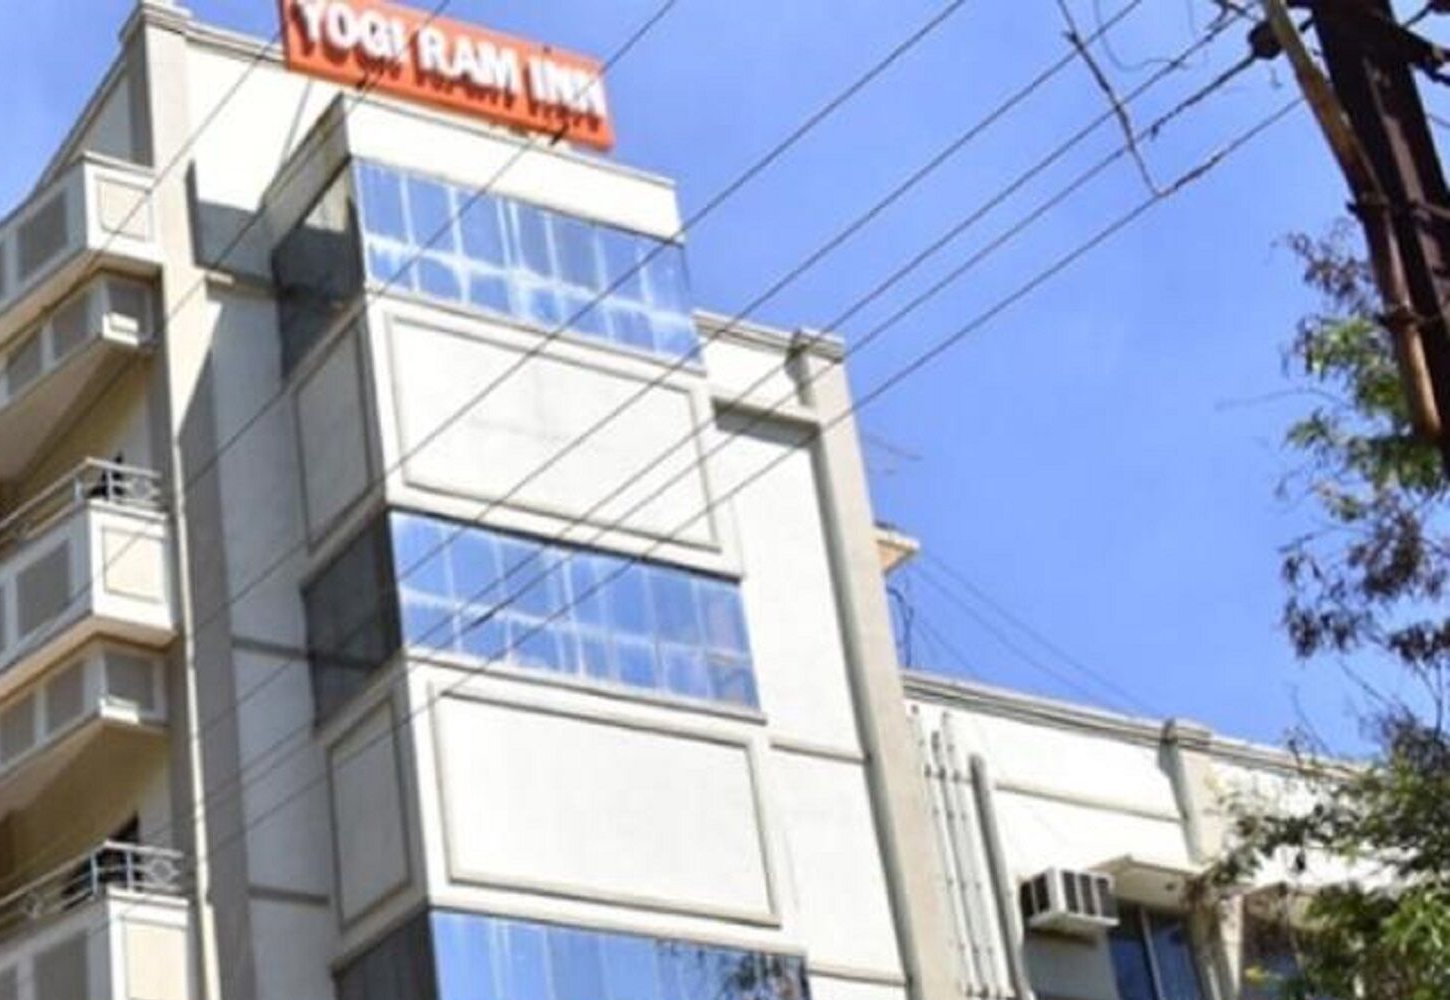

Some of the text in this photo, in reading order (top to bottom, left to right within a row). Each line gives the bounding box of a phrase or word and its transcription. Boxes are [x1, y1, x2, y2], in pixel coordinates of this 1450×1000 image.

[298, 0, 608, 118] YOGI RAM INN
